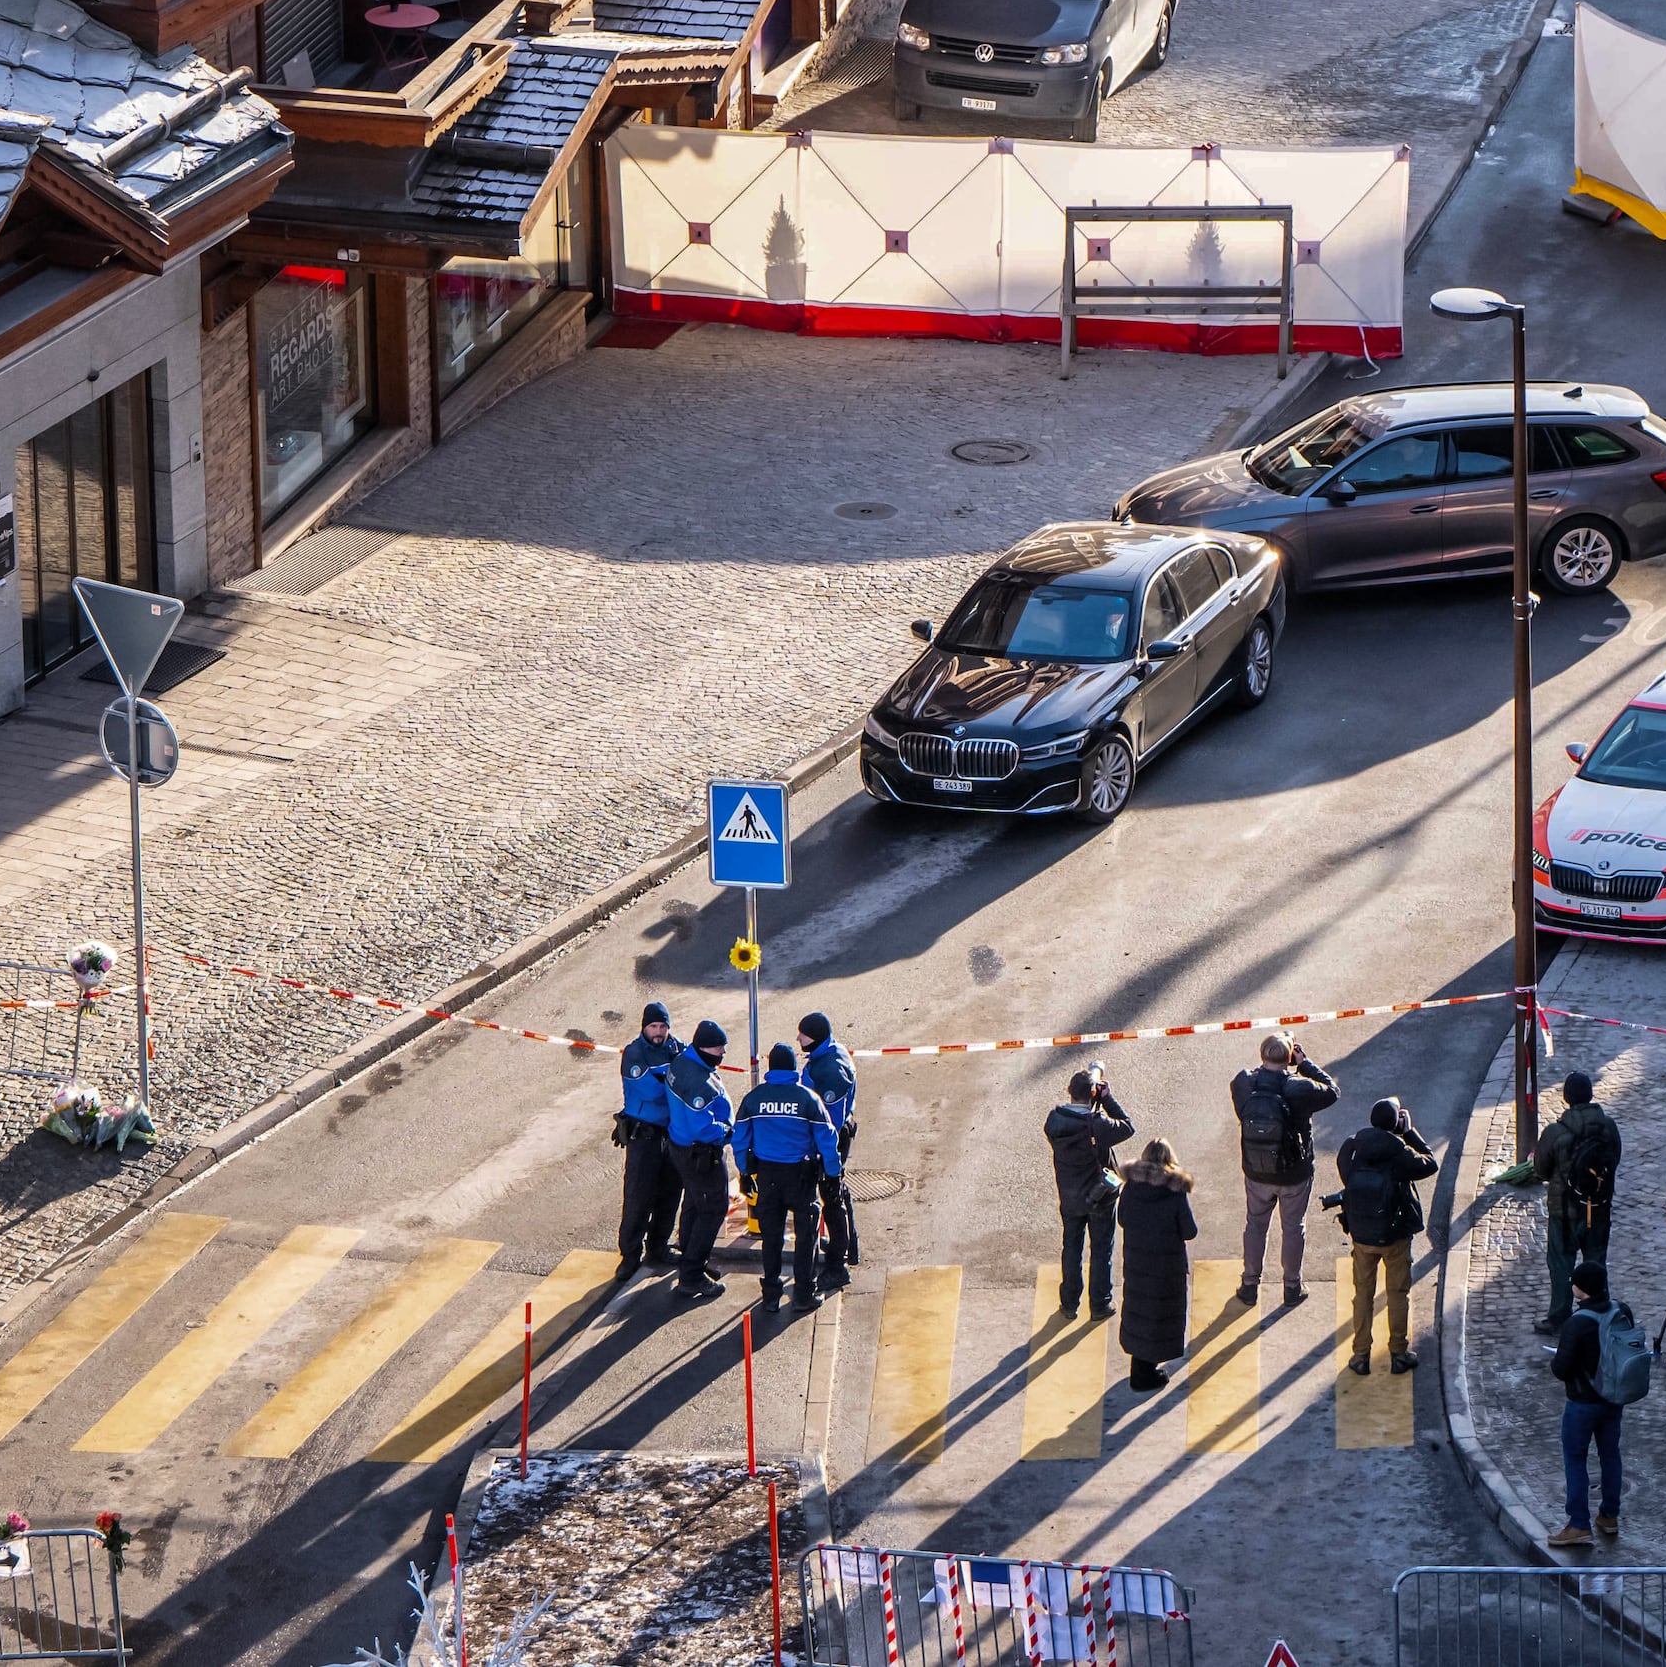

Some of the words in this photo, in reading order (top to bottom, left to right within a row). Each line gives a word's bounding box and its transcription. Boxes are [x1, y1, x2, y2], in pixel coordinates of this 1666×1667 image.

[269, 280, 333, 352] GALERIE
[270, 304, 333, 383] REGARDS
[271, 372, 293, 407] ART
[297, 334, 334, 383] PHOTO
[759, 1102, 799, 1114] POLICE
